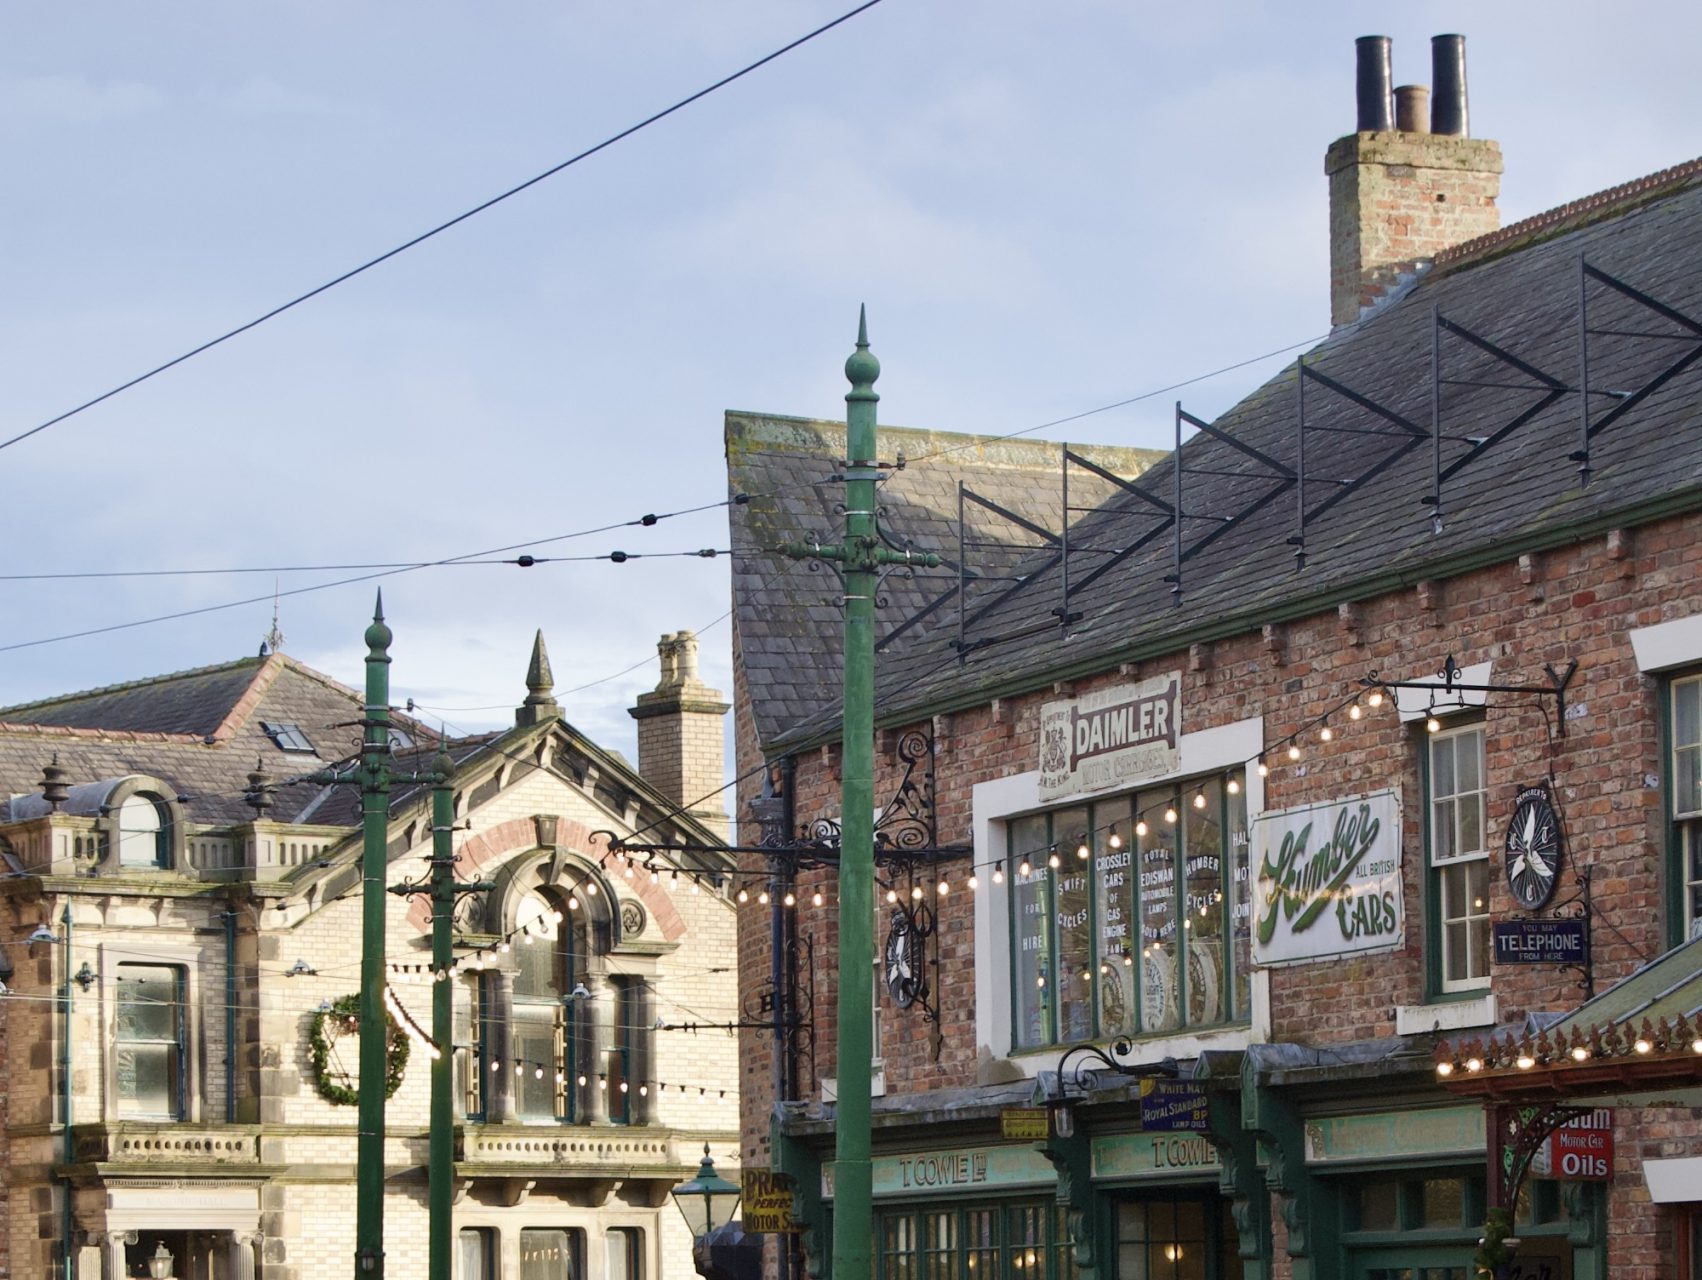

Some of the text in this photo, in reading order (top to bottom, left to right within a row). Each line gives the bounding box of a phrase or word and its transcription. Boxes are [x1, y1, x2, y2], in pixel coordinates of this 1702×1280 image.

[1076, 700, 1168, 755] DAIMLER
[1232, 832, 1248, 847] HAL
[1096, 852, 1131, 871] CROSSLEY
[1144, 850, 1169, 863] ROYAL
[1186, 856, 1219, 877] HUMBER
[1258, 804, 1380, 944] Humber
[1355, 859, 1395, 878] ALL BRITISH
[1013, 867, 1048, 886] MACHINES
[1103, 872, 1124, 888] CARS
[1140, 868, 1174, 887] EDISWAN
[1058, 877, 1085, 896] SWIFT
[1109, 893, 1118, 903] OF
[1186, 888, 1220, 909] CYCLES
[1025, 902, 1040, 914] FOR
[1107, 908, 1121, 921] GAS
[1148, 902, 1168, 914] LAMPS
[1336, 884, 1396, 941] CARS
[1057, 908, 1087, 928] CYCLES
[1103, 924, 1127, 938] ENGINE
[1023, 936, 1042, 951] HIRE
[1499, 934, 1580, 951] TELEPHONE
[1519, 951, 1563, 960] FROM HERE
[1159, 1083, 1184, 1094] WHITE
[1144, 1107, 1168, 1122] ROYAL
[1169, 1096, 1207, 1115] STANDARD
[1193, 1110, 1208, 1121] BP
[1191, 1121, 1206, 1129] OILS
[1560, 1109, 1611, 1129] uum
[1560, 1133, 1604, 1149] MOTOR CAR
[1167, 1136, 1217, 1167] COWIE
[914, 1154, 968, 1187] COWIE
[1562, 1153, 1608, 1176] Oils
[754, 1198, 793, 1209] PERFEC
[745, 1212, 779, 1230] MOTOR
